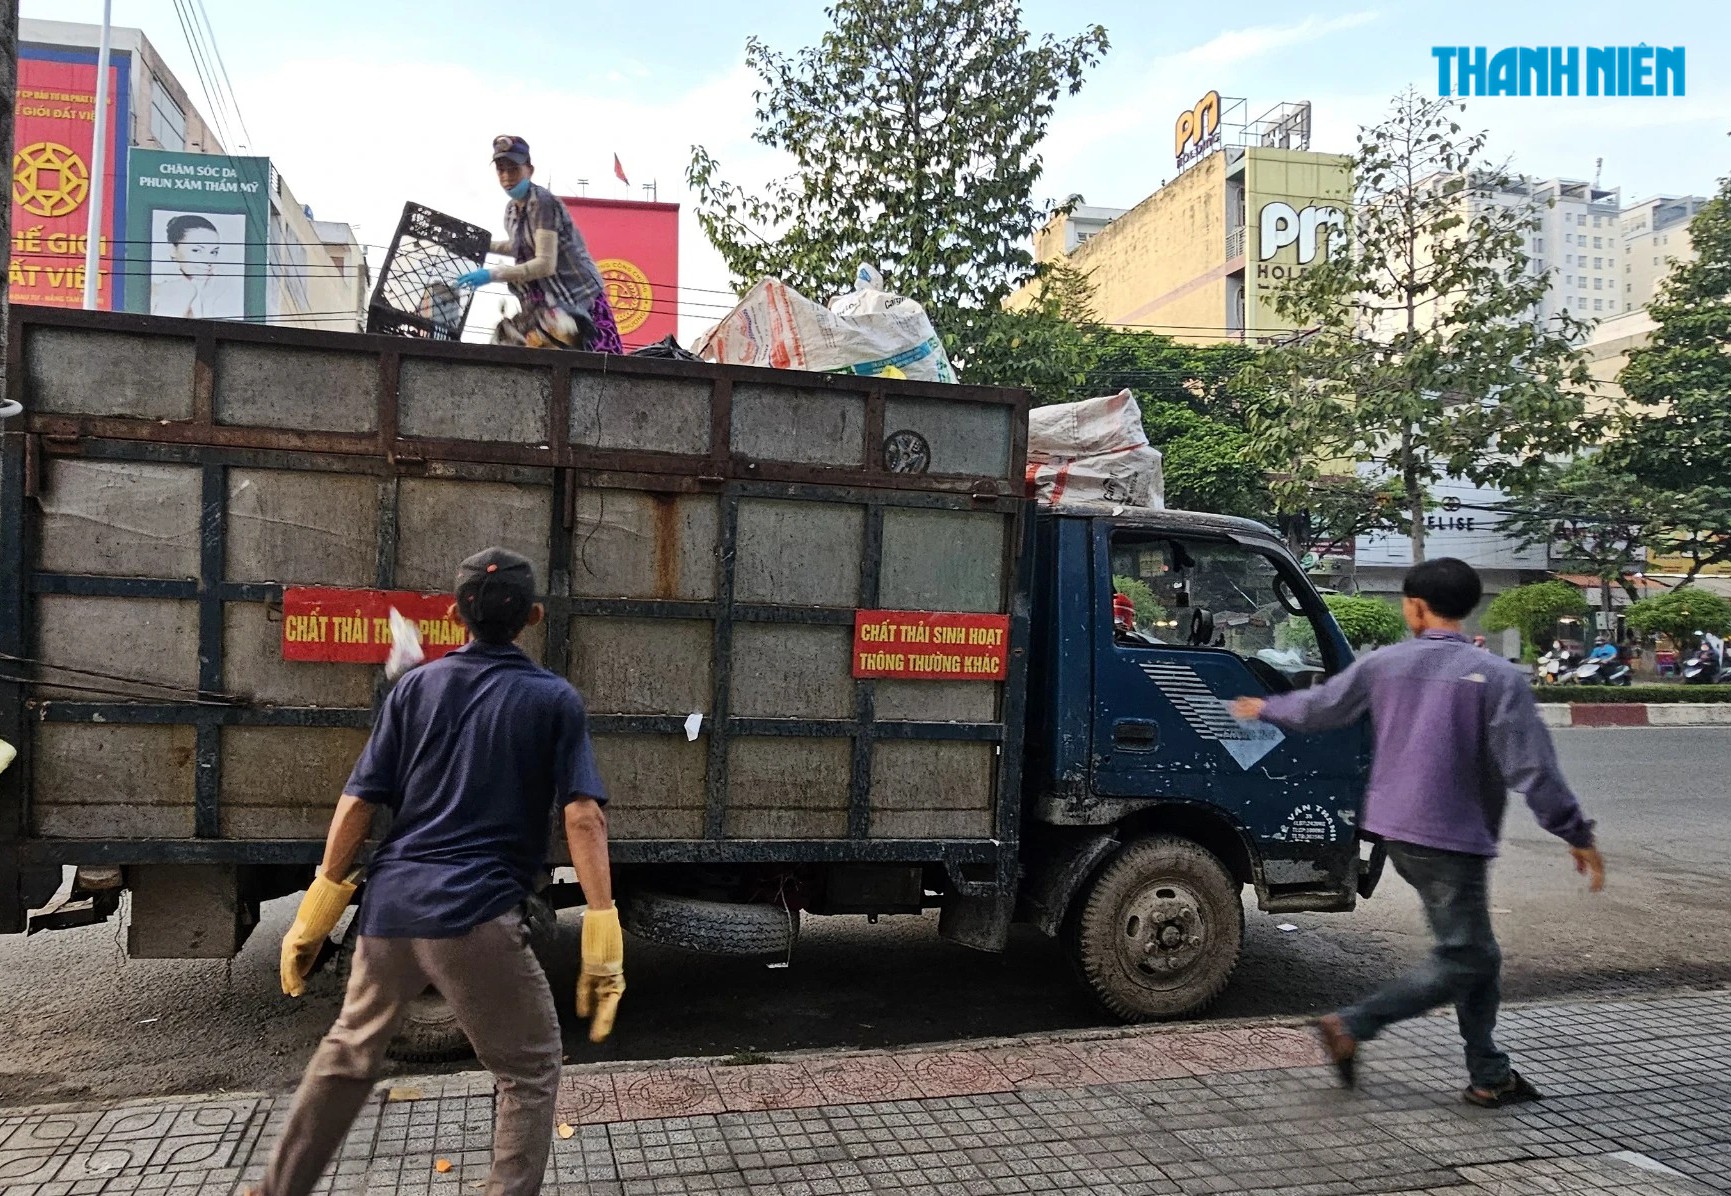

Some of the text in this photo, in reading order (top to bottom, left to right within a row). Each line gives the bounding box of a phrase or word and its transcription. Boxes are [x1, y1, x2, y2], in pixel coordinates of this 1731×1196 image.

[139, 176, 172, 188] PHUN
[196, 165, 220, 177] SÓC
[8, 259, 42, 287] ẤT
[1421, 514, 1475, 531] ELISE
[286, 606, 329, 642] CHẤT
[333, 609, 369, 644] THẢI
[861, 619, 1003, 648] CHẤT THẢI SINH HOẠT
[860, 650, 1000, 673] THÔNG THƯỜNG KHÁC
